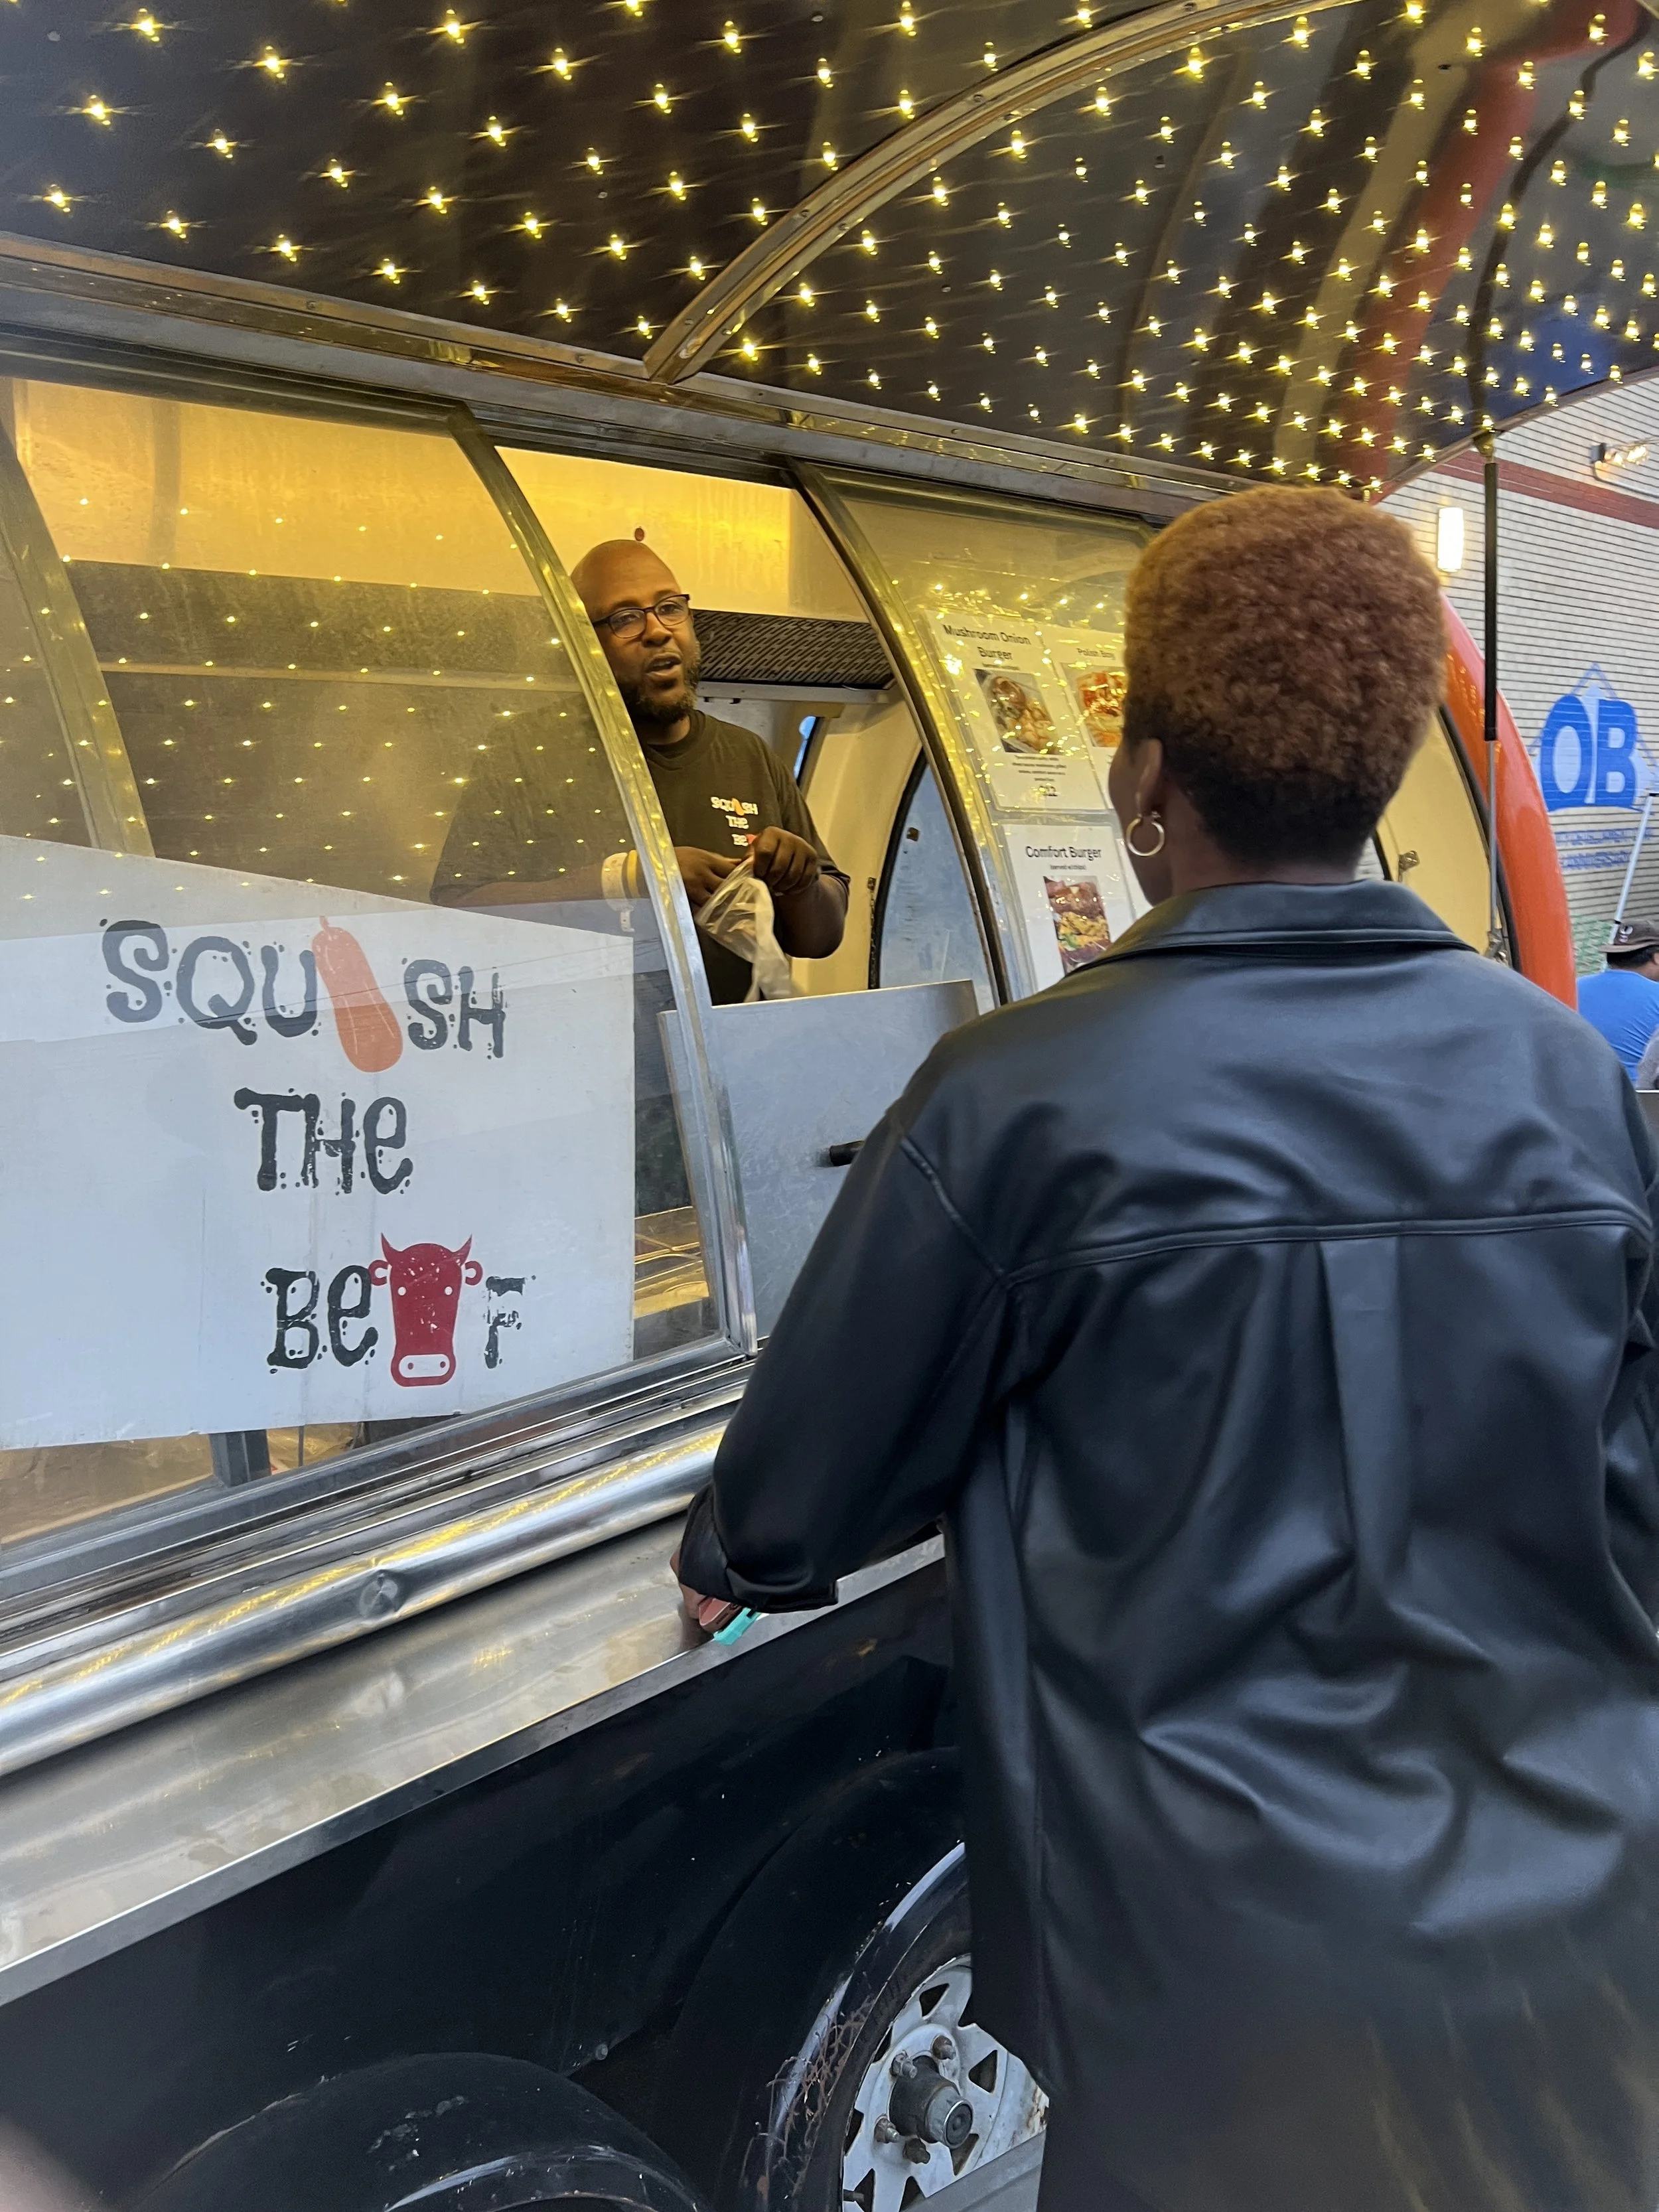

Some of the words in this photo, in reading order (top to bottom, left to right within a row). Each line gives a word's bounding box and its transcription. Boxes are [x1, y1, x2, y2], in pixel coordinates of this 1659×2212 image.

[942, 624, 1000, 641] Mushroom
[1000, 632, 1031, 645] Onion
[977, 646, 1013, 661] Burger
[1026, 846, 1068, 858] Comfort
[1068, 846, 1102, 861] Burger
